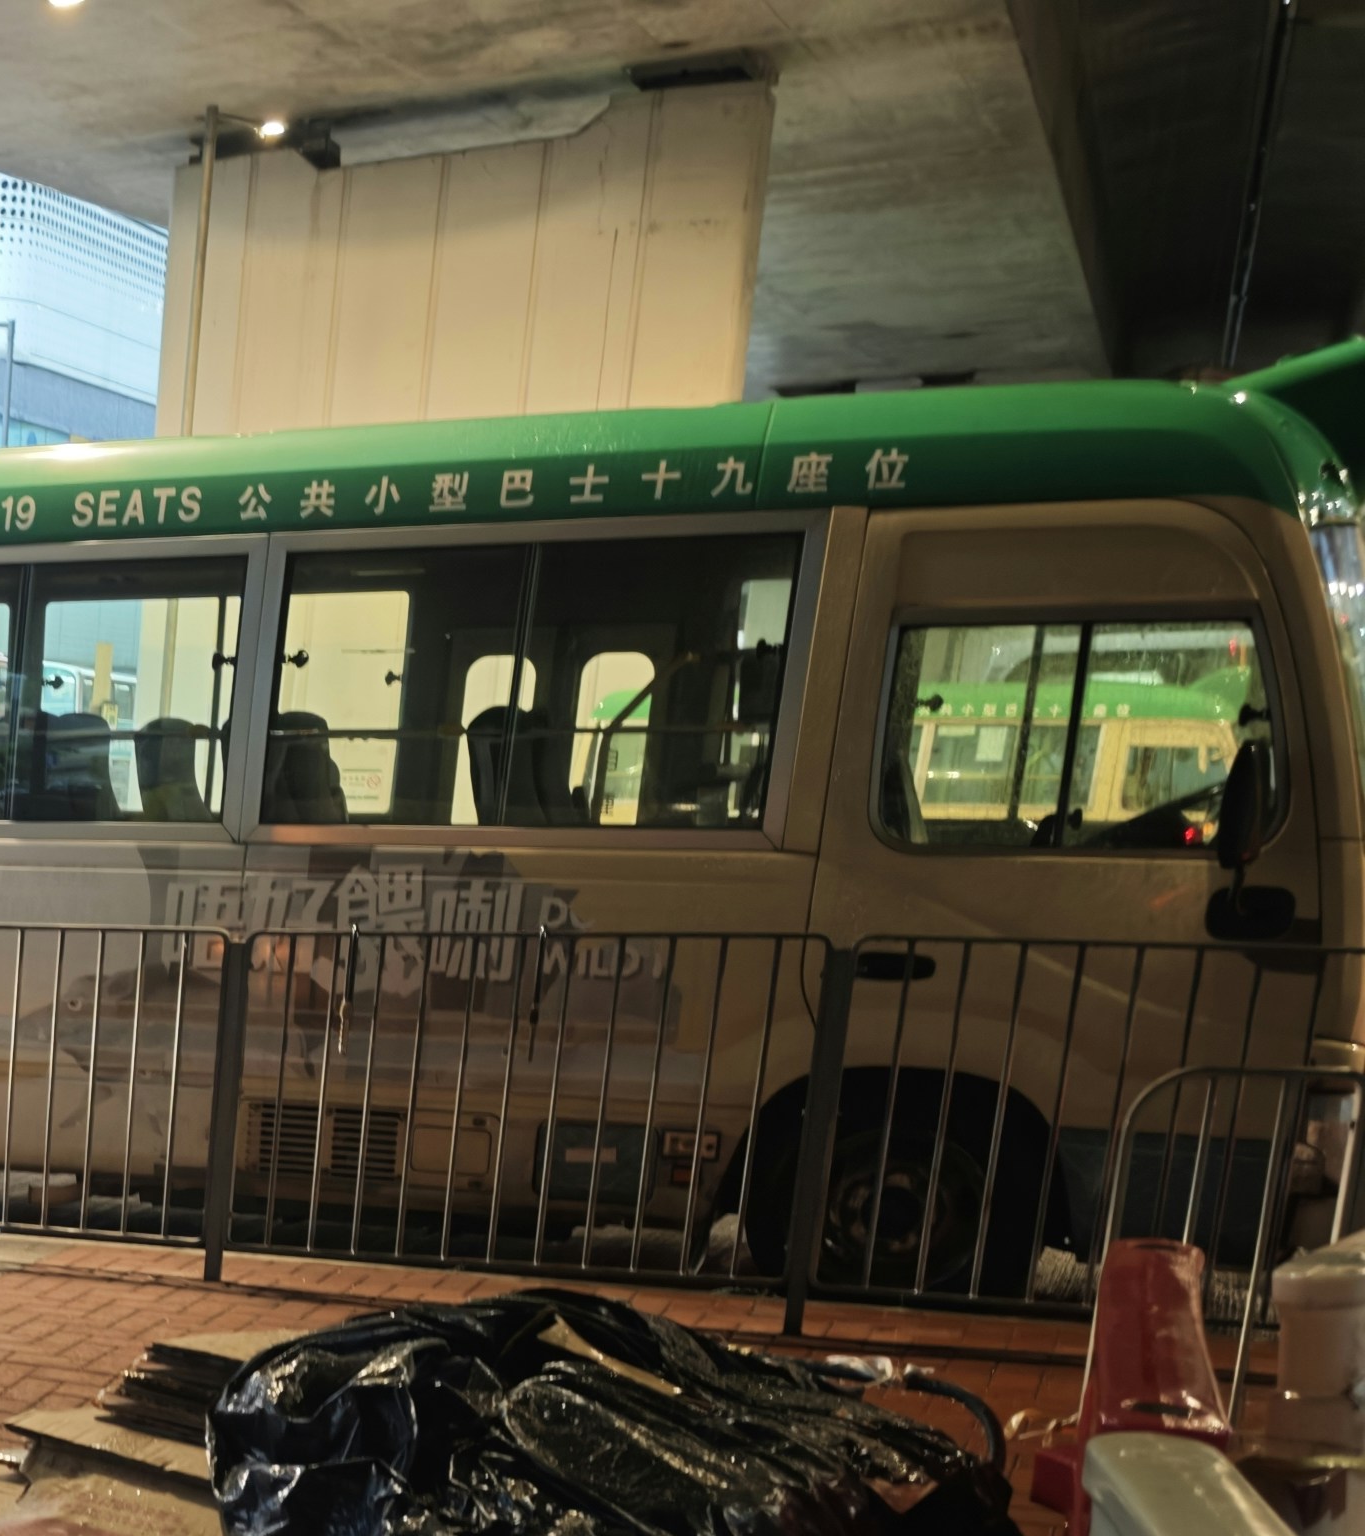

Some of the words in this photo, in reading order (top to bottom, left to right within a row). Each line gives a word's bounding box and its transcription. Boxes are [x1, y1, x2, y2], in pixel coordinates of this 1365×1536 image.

[1, 495, 36, 532] 19
[71, 486, 202, 528] SEATS
[237, 448, 910, 522] 公共小型巴士十九座位
